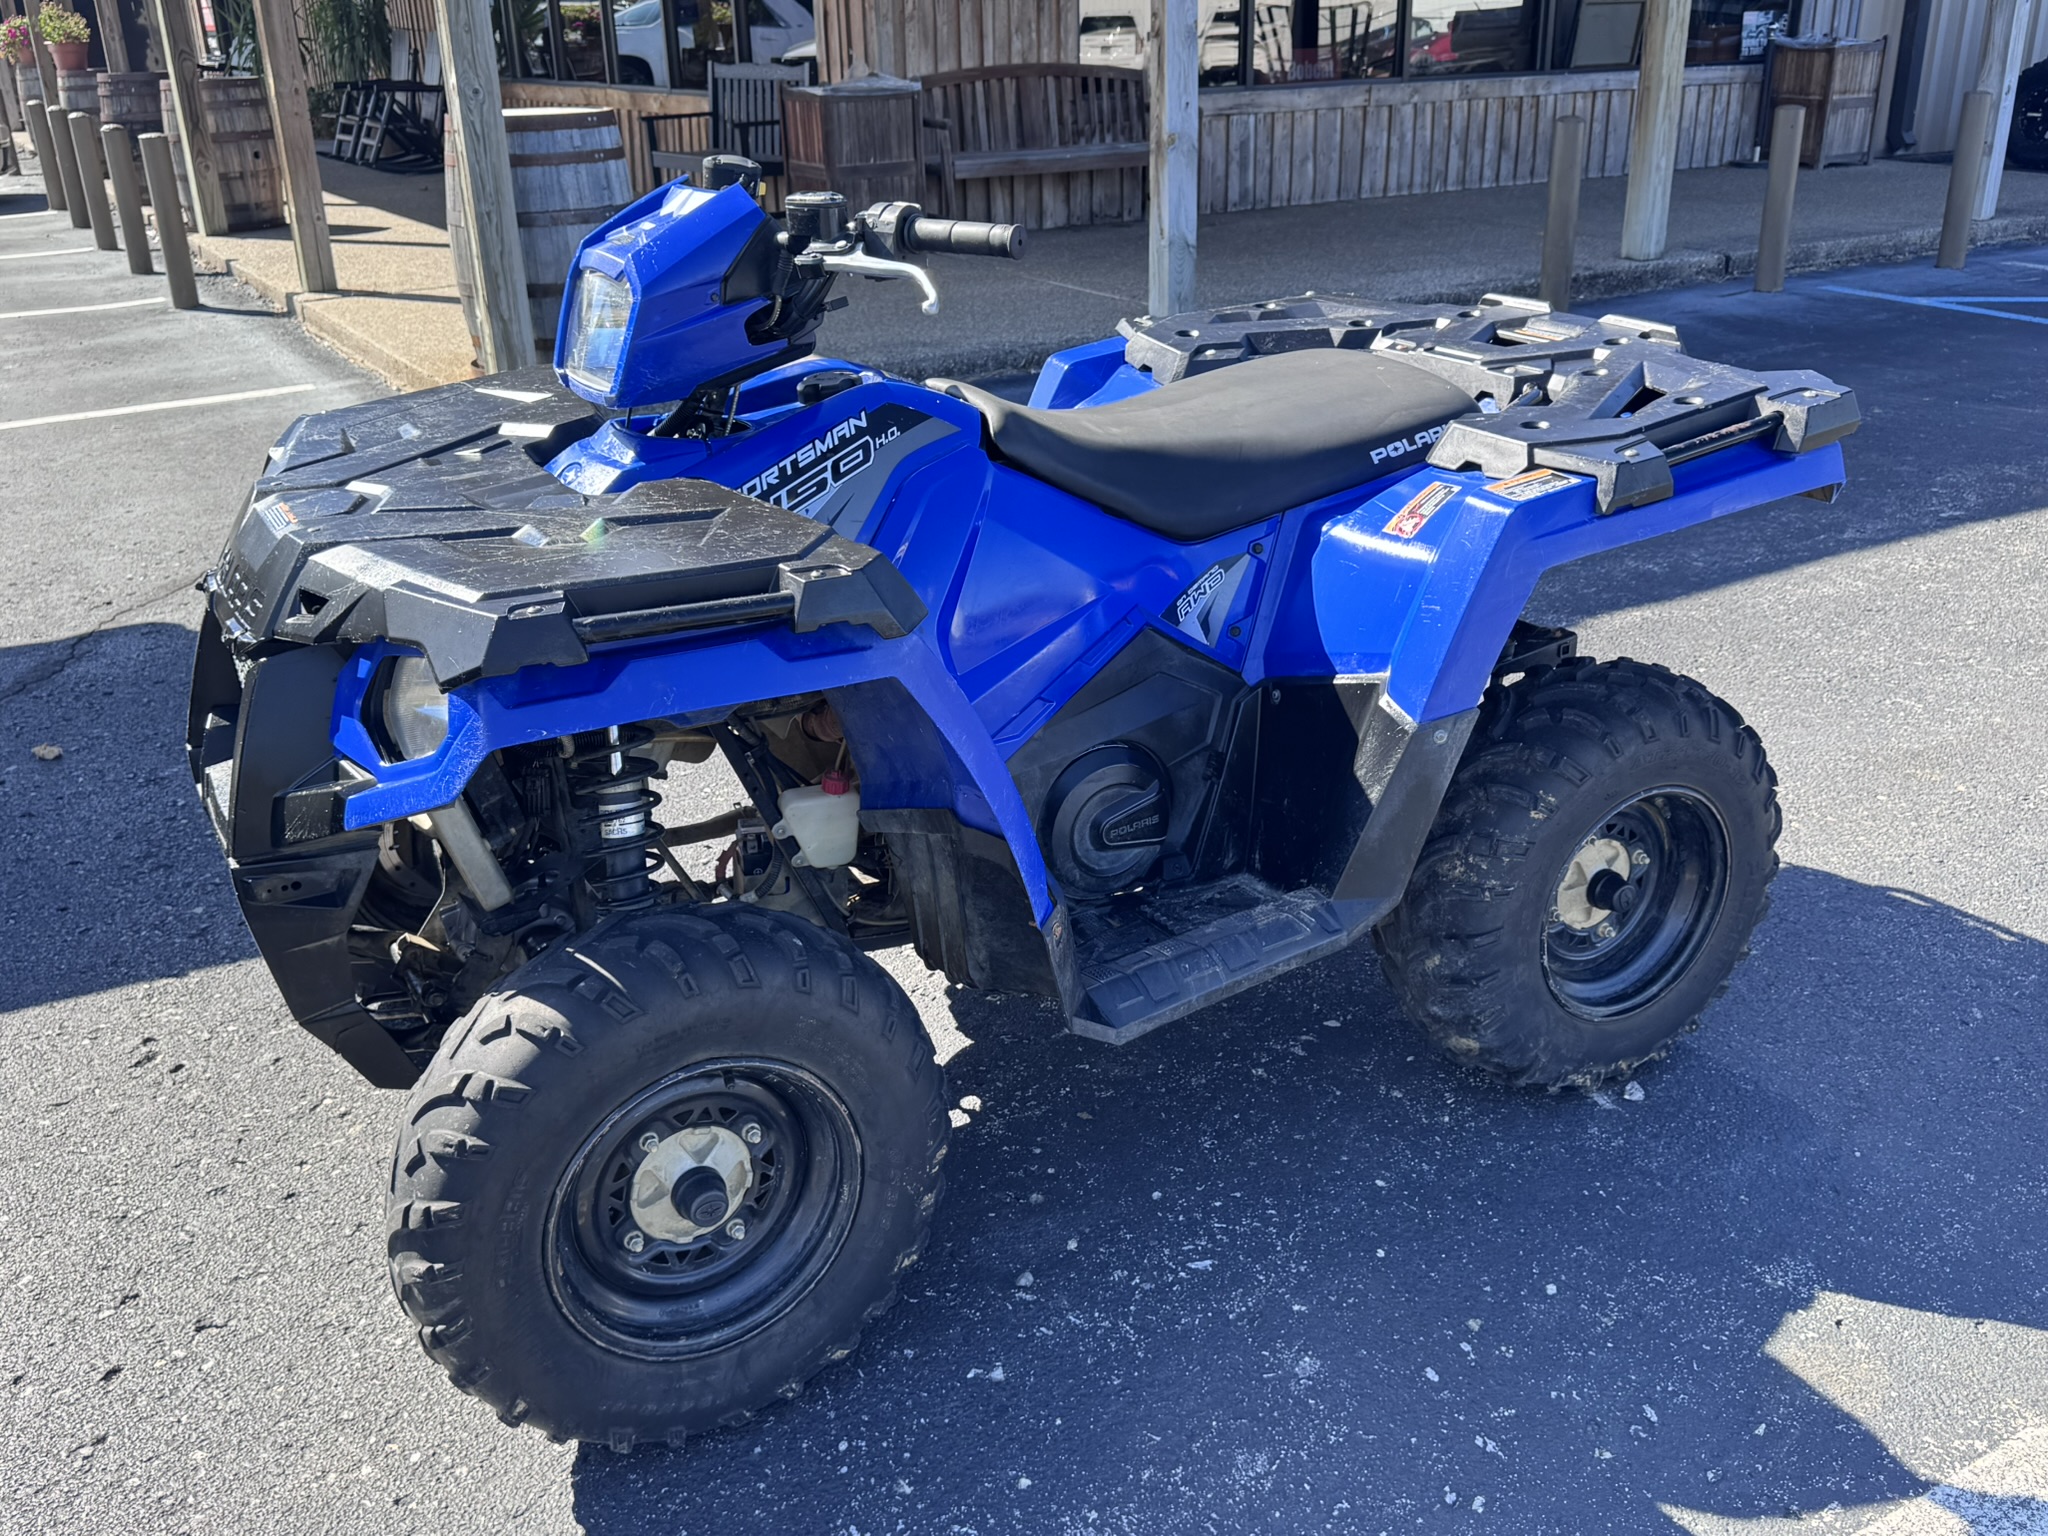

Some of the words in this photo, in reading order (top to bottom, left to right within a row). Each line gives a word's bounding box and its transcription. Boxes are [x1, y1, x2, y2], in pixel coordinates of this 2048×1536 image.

[1287, 60, 1334, 80] Bobcat
[737, 410, 868, 498] ORTSMAN
[875, 426, 901, 449] H.O.
[1369, 424, 1446, 465] POLAR
[769, 435, 875, 513] 50
[1177, 568, 1225, 622] AWD
[1110, 814, 1160, 839] POLARIS
